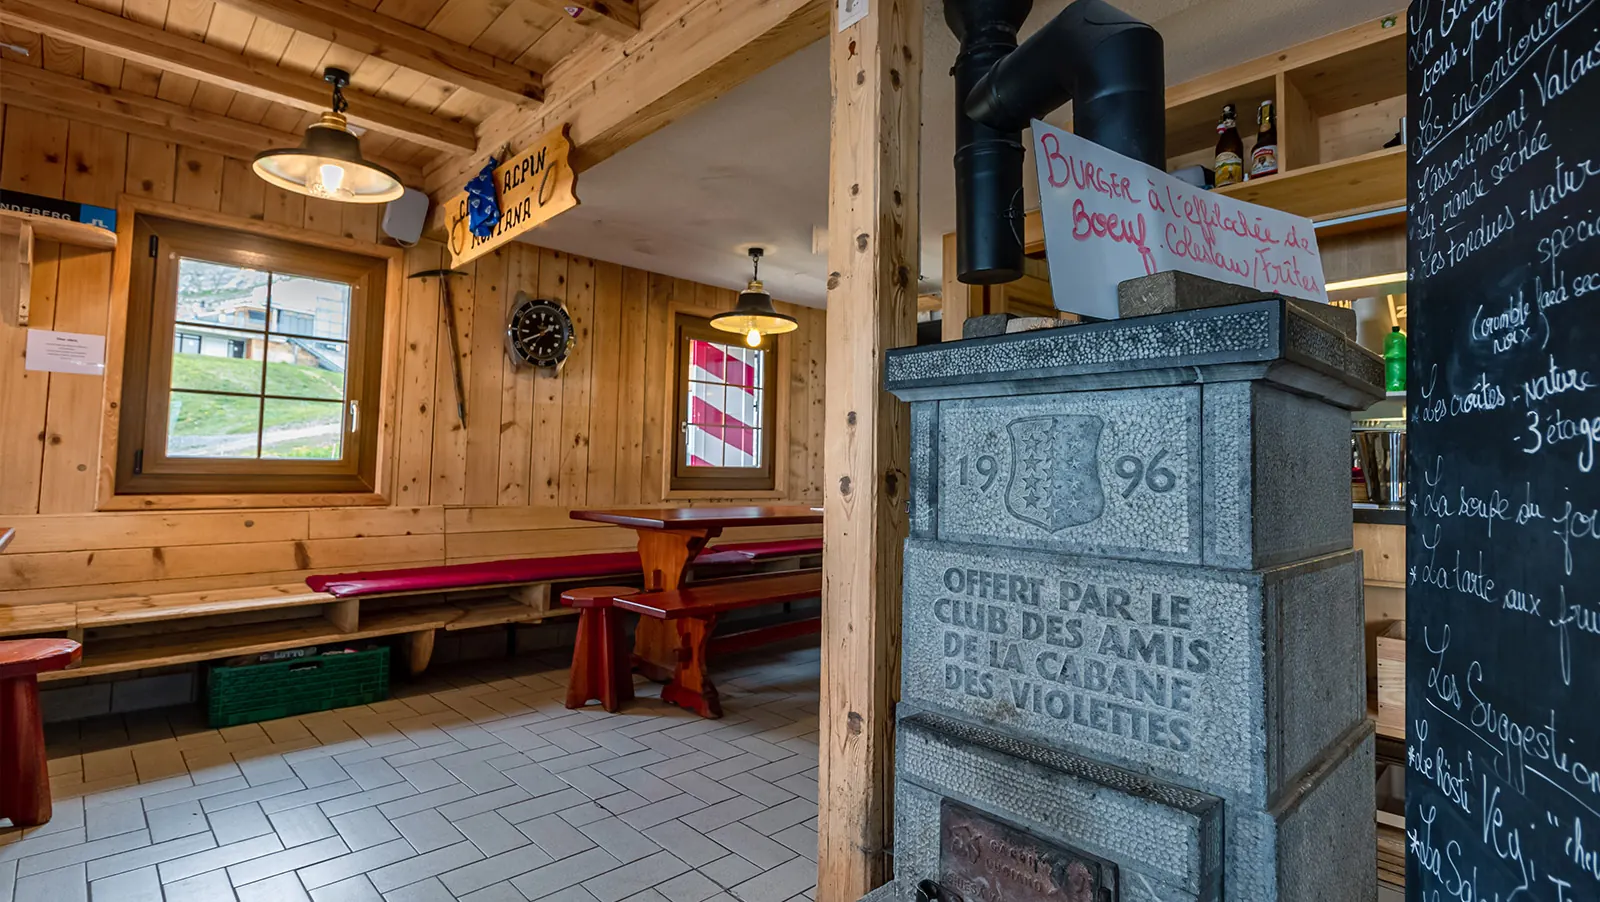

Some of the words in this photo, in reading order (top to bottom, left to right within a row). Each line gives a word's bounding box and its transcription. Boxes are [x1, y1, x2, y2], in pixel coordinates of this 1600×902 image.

[1412, 96, 1443, 157] Les
[1448, 0, 1582, 127] incontour
[502, 147, 547, 195] ALPIN
[1284, 225, 1315, 255] de
[1422, 363, 1447, 422] Les
[958, 453, 999, 493] 19
[1114, 451, 1176, 499] 96
[1424, 455, 1455, 517] La
[1458, 486, 1513, 538] soupe
[1515, 482, 1546, 525] du
[943, 567, 1045, 606] OFFERT
[1059, 580, 1136, 623] PAR
[1151, 592, 1192, 630] LE
[1422, 523, 1450, 590] La
[1503, 588, 1541, 616] aux
[933, 598, 1008, 635] CLUB
[1021, 611, 1084, 649] DES
[1097, 625, 1213, 674] AMIS
[943, 631, 979, 661] DE
[989, 640, 1026, 675] LA
[1036, 651, 1193, 713] CABANE
[1424, 624, 1461, 711] Les
[944, 663, 994, 700] DES
[1010, 678, 1193, 751] VIOLETTES
